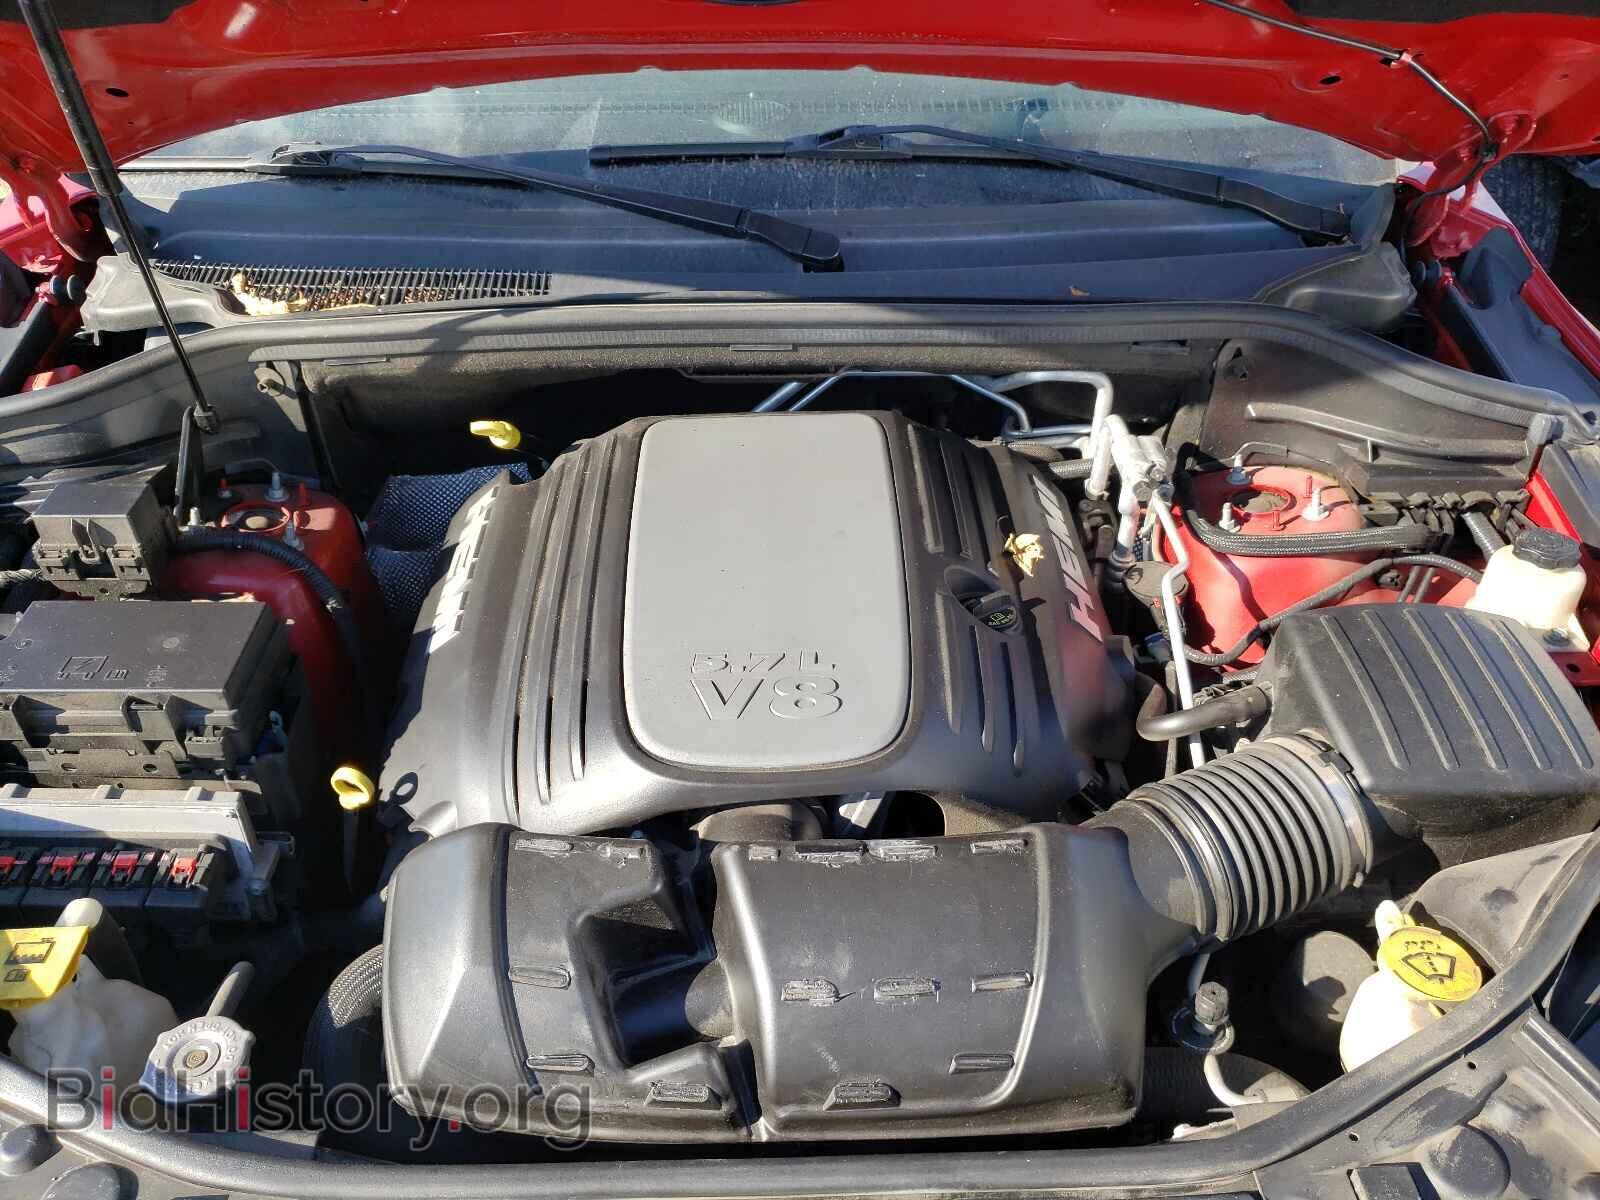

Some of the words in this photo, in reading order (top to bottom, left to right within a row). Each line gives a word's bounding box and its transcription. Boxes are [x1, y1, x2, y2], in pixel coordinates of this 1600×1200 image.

[1032, 474, 1103, 642] HEMI
[689, 650, 836, 673] 5.7L
[690, 677, 843, 720] V8
